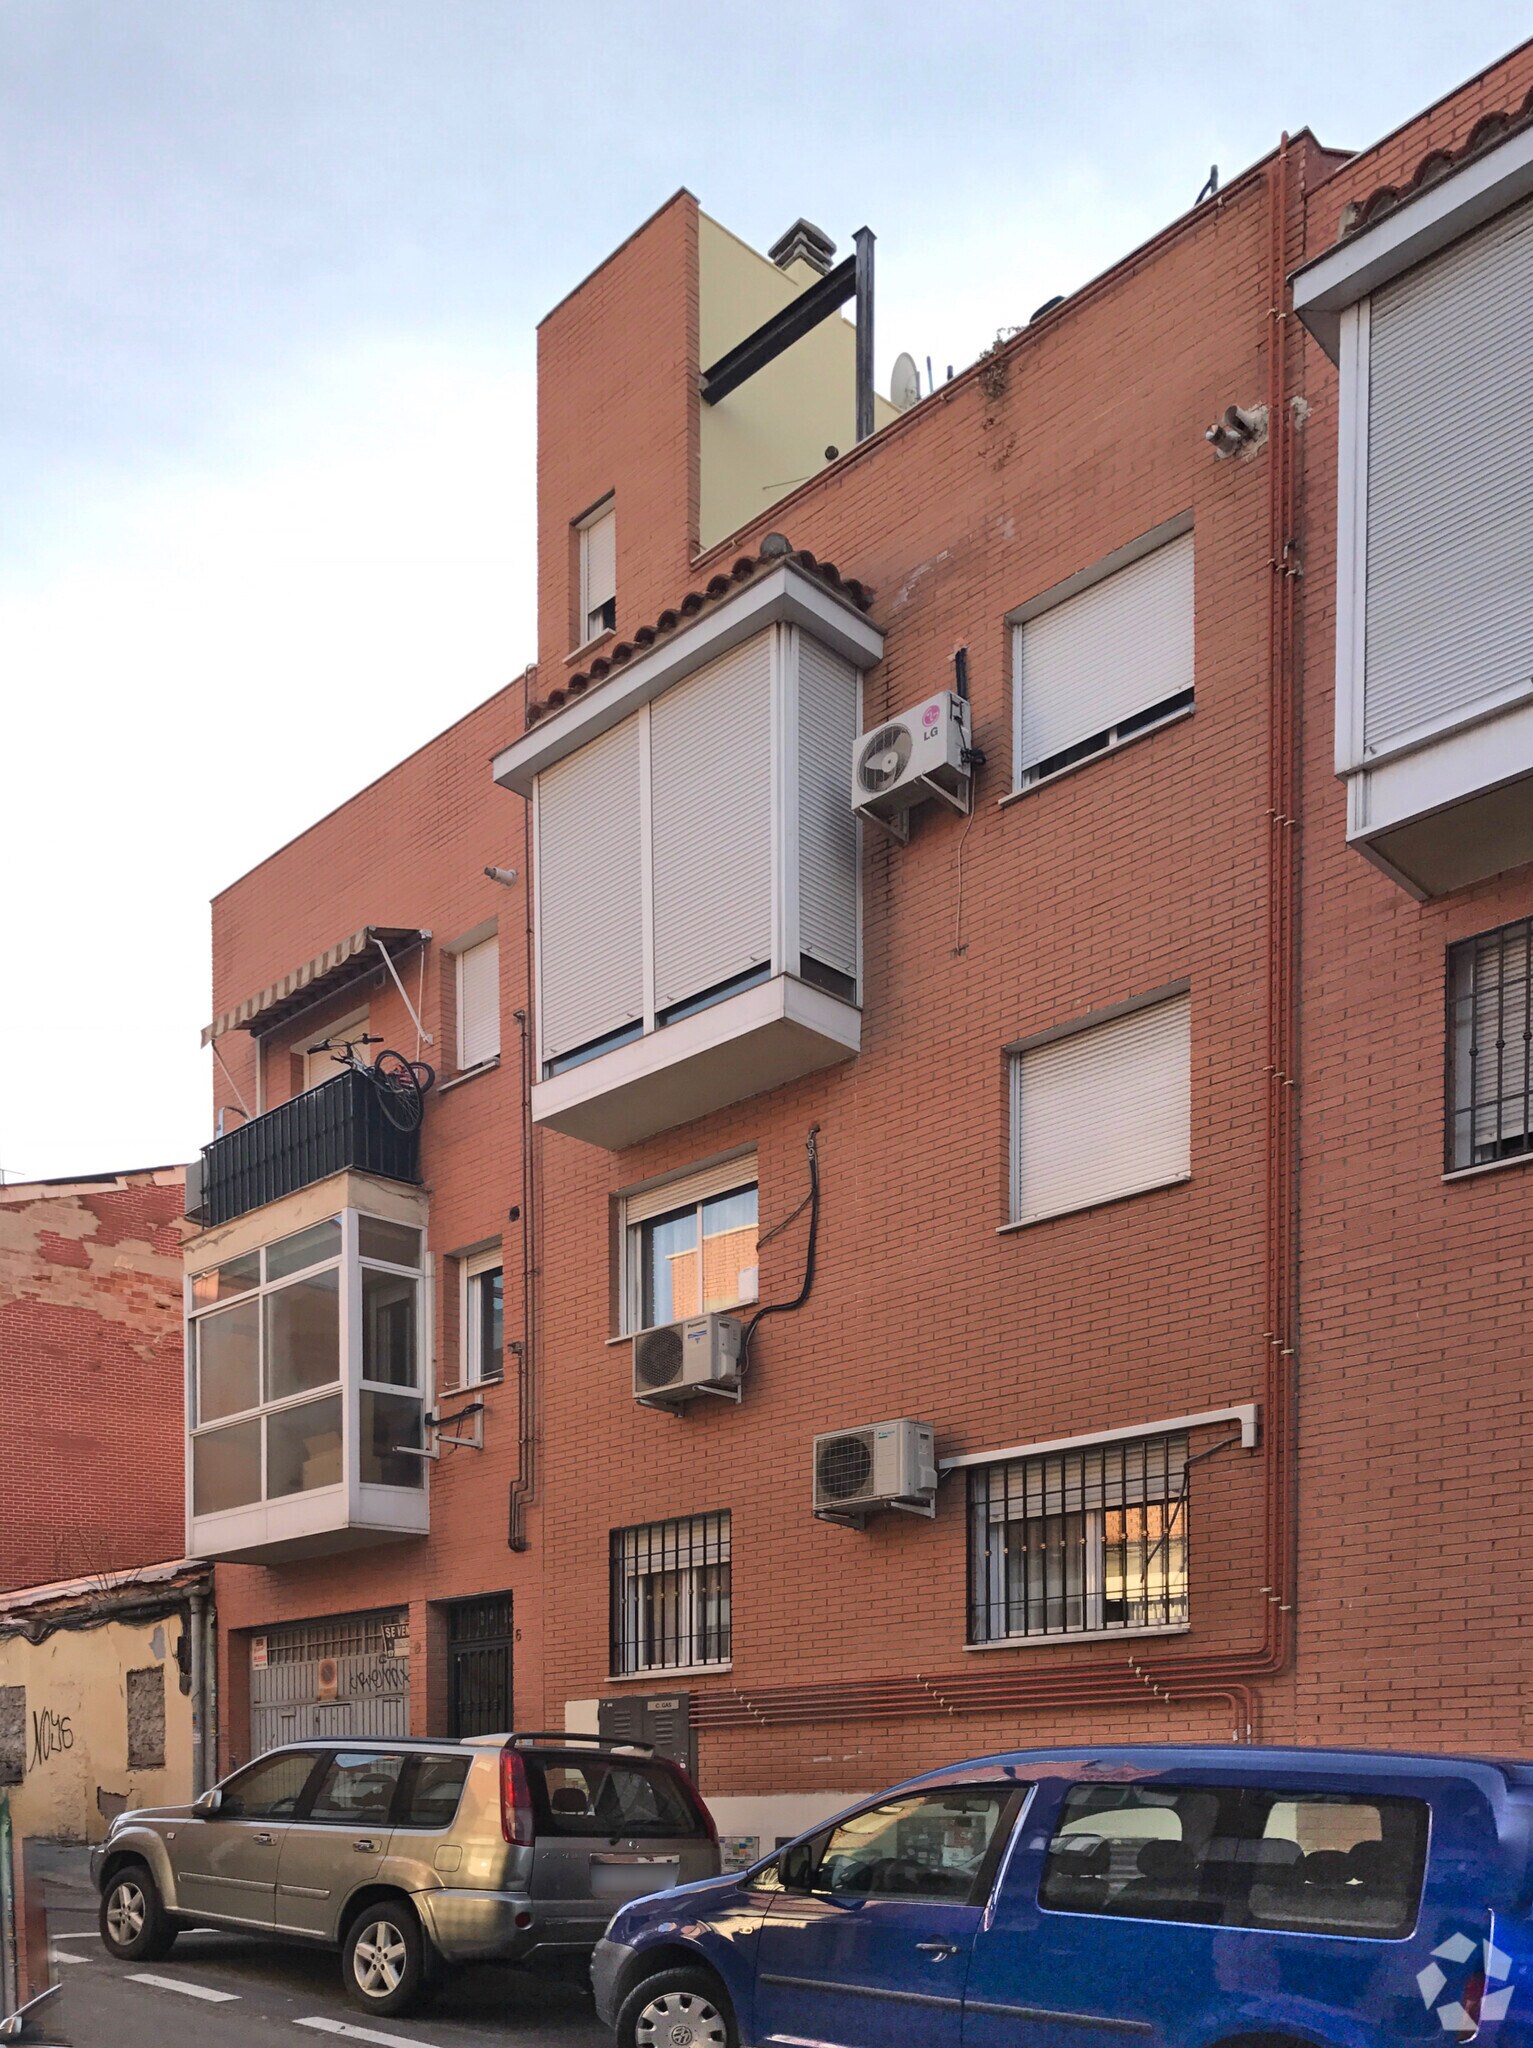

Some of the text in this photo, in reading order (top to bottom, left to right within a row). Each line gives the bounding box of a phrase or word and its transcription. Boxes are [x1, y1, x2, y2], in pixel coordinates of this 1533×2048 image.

[924, 727, 938, 741] LG
[385, 1626, 396, 1638] SE
[516, 1628, 522, 1641] 6
